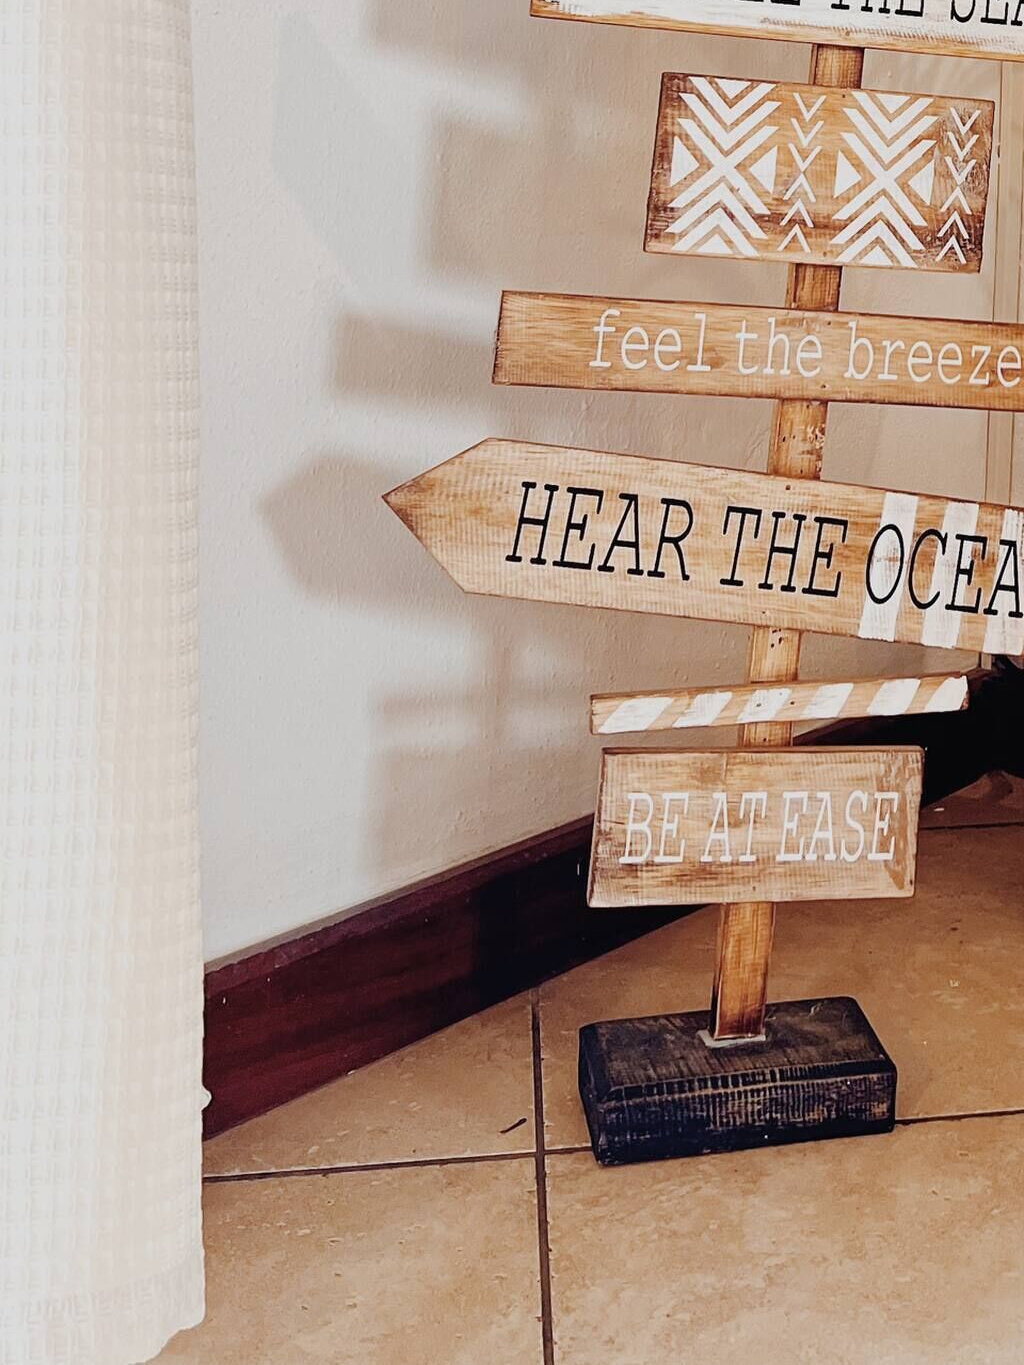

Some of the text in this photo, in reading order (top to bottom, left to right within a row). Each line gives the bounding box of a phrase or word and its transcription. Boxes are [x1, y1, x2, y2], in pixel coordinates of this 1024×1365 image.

[588, 309, 1023, 389] feel the breeze
[505, 481, 694, 581] HEAR
[719, 504, 849, 598] THE
[618, 790, 899, 864] BE AT EASE
